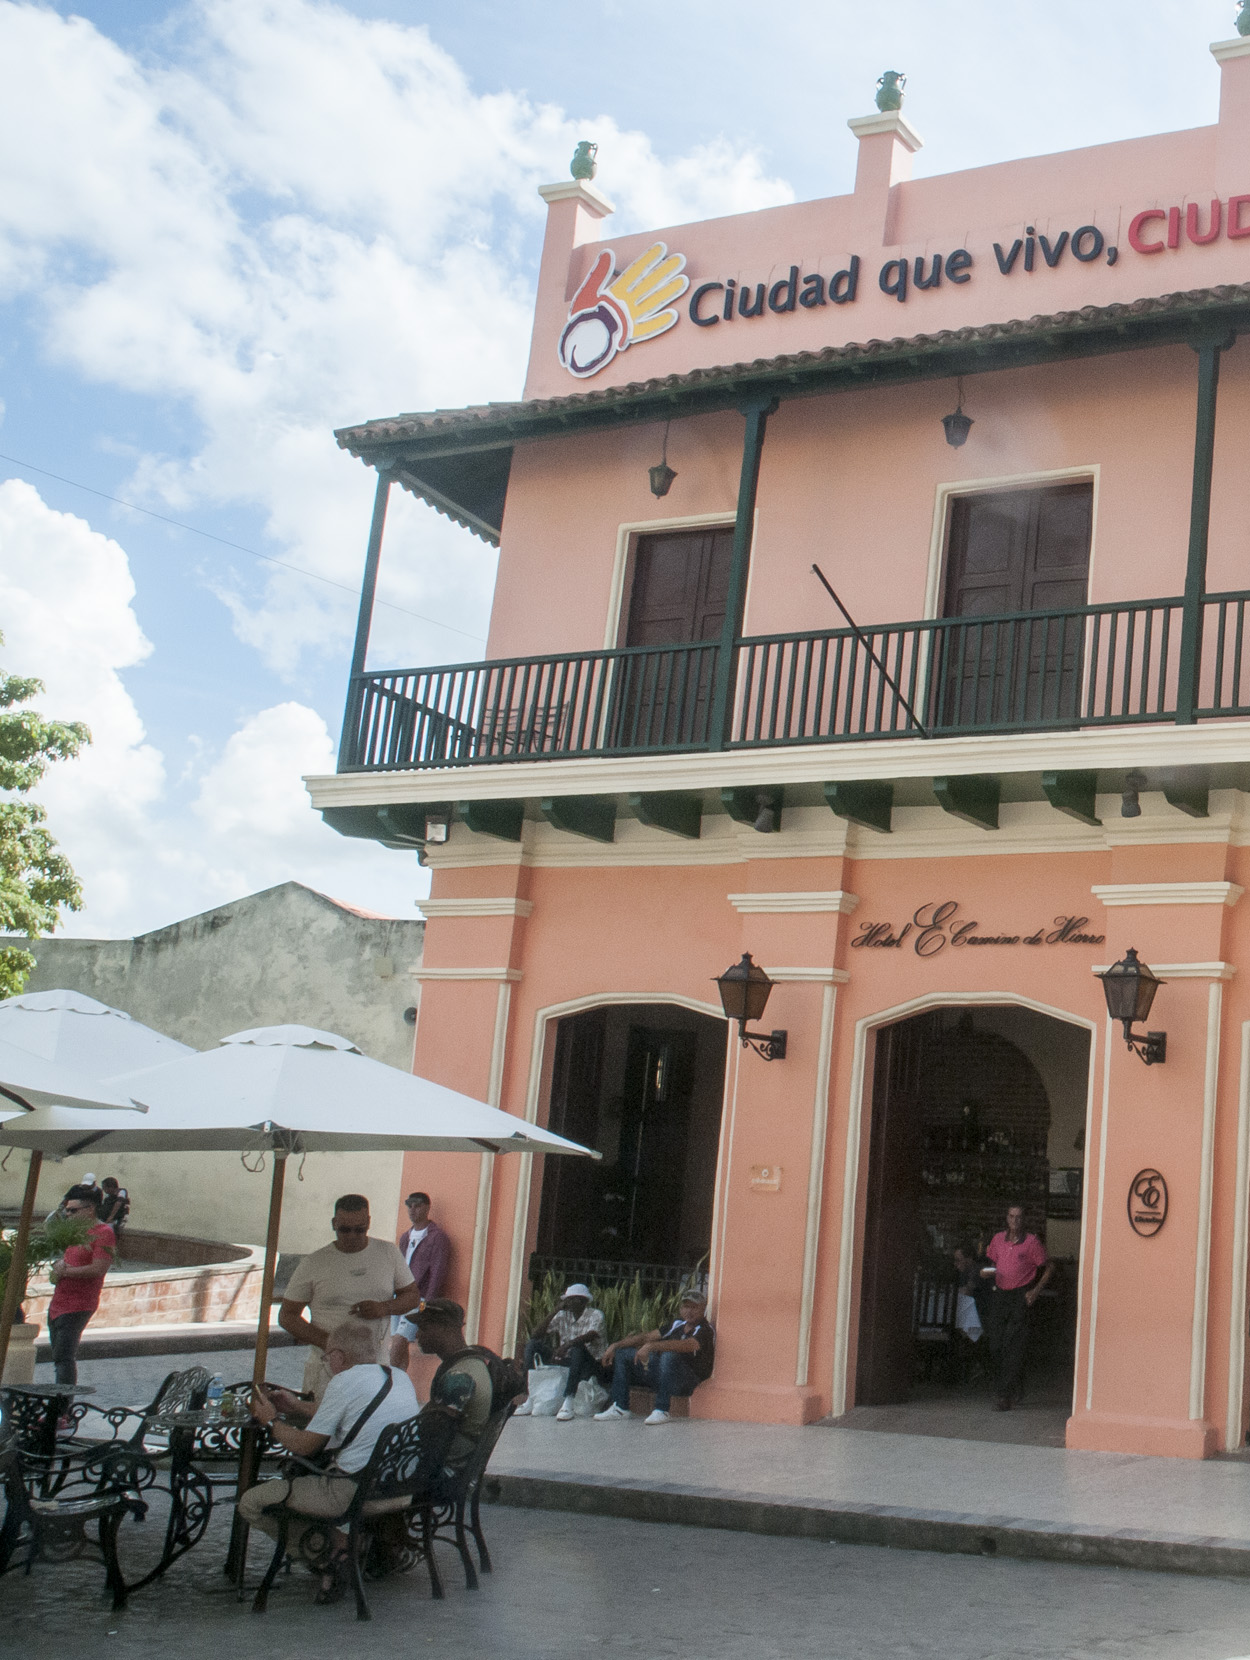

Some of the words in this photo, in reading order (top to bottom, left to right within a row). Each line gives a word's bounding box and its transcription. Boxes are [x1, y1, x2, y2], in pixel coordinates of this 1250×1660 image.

[688, 255, 860, 328] Ciudad
[878, 246, 973, 303] que
[992, 224, 1119, 277] vivo,
[850, 922, 911, 949] Hotel
[950, 920, 1021, 947] Camino
[1022, 928, 1045, 946] de
[1045, 915, 1106, 945] Hierro
